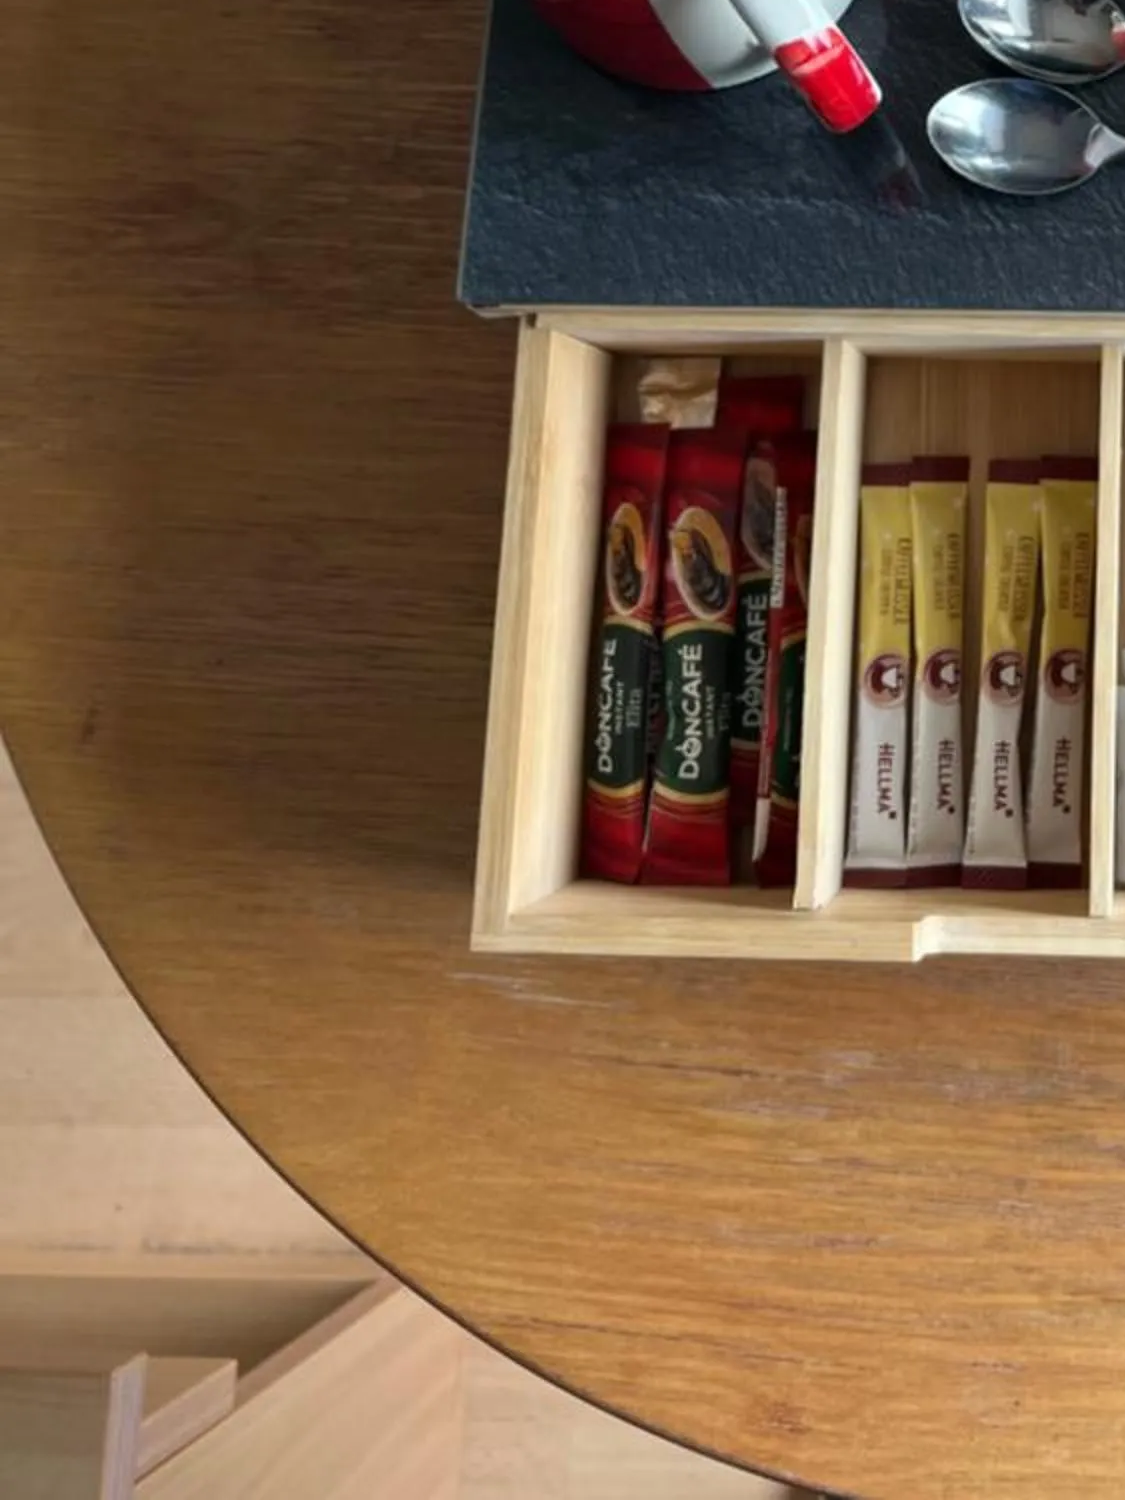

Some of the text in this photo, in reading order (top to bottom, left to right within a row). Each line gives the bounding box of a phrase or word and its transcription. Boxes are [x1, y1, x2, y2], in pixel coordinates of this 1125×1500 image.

[877, 741, 896, 815] HELLMA
[936, 739, 955, 811] HELLMA
[993, 740, 1011, 812] HELLMA
[1052, 736, 1072, 808] HELLMA
